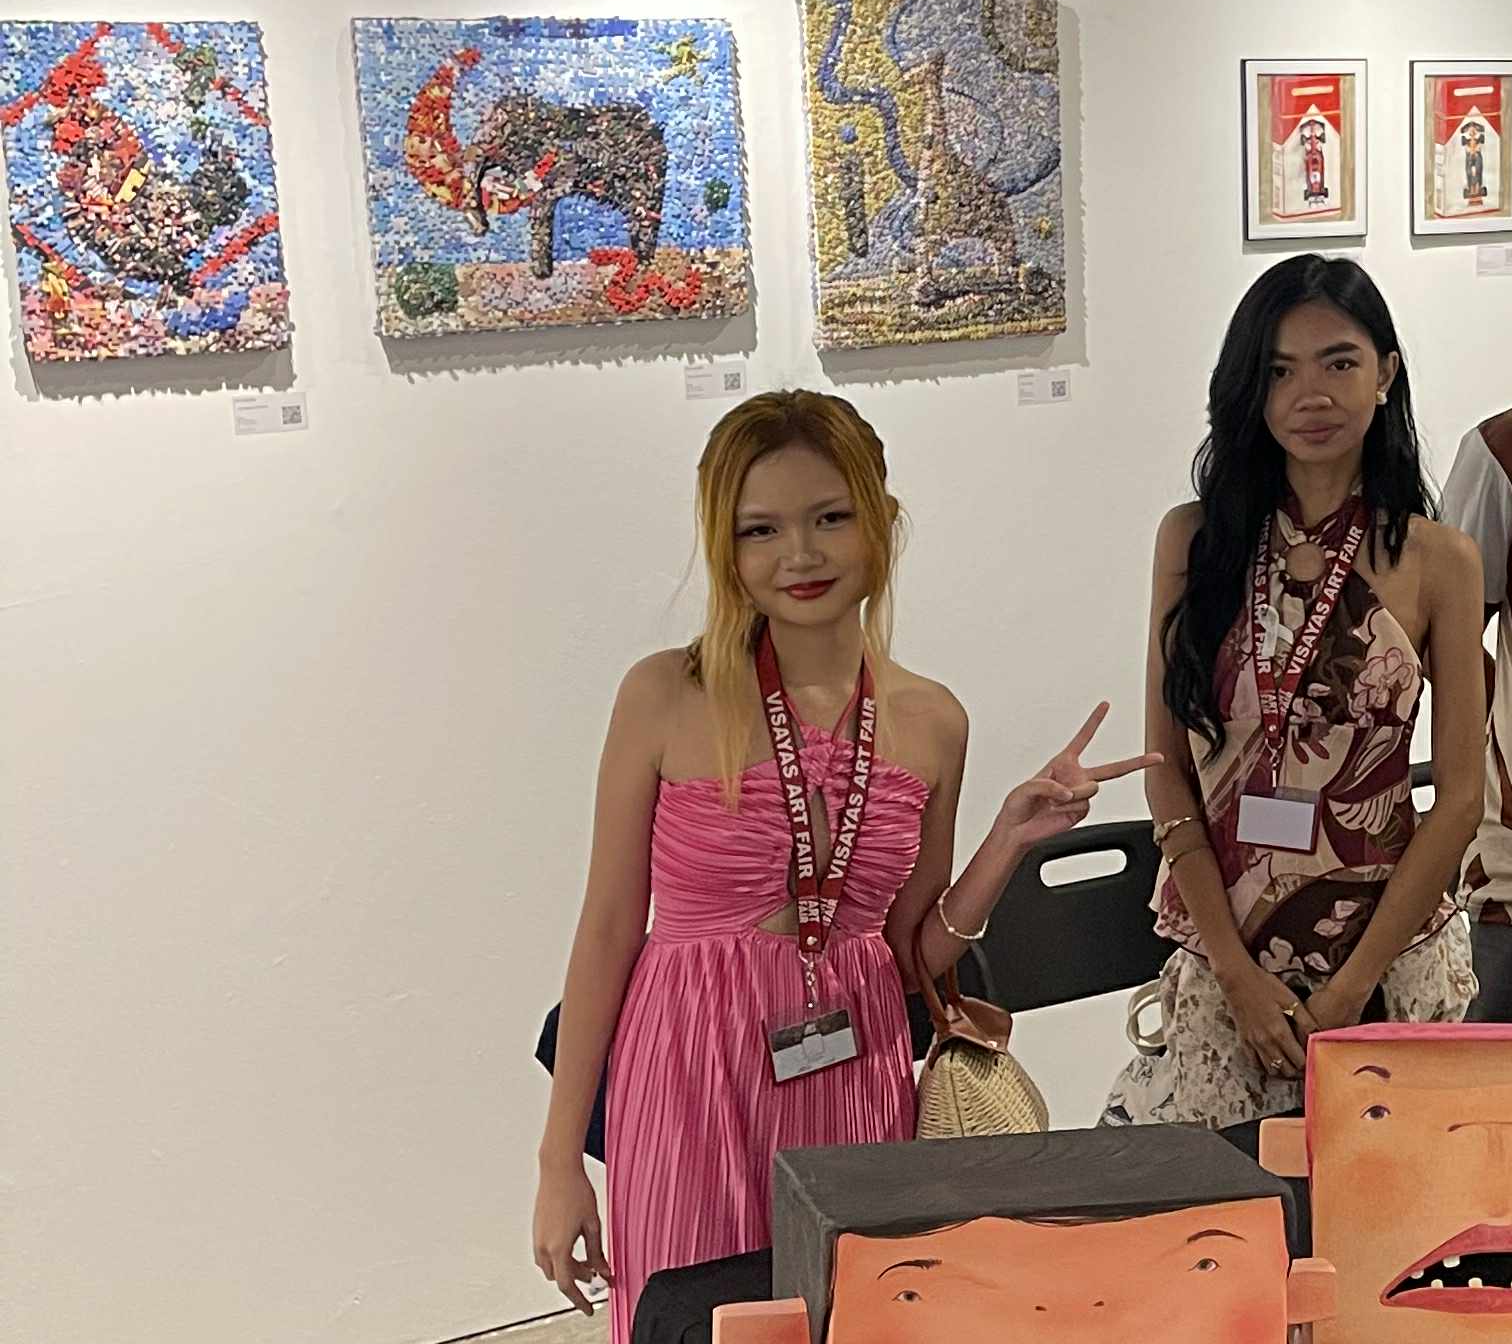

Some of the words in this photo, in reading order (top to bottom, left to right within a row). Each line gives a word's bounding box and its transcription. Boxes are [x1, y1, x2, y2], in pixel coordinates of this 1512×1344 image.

[1287, 601, 1330, 674] VISAYAS
[1323, 564, 1347, 601] ART
[1339, 525, 1364, 563] FAIR
[765, 690, 799, 780] VISAYAS
[860, 696, 876, 747] FAIR
[853, 748, 871, 791] ART
[786, 783, 809, 825] ART
[796, 831, 814, 879] FAIR
[827, 793, 863, 880] VISAYAS
